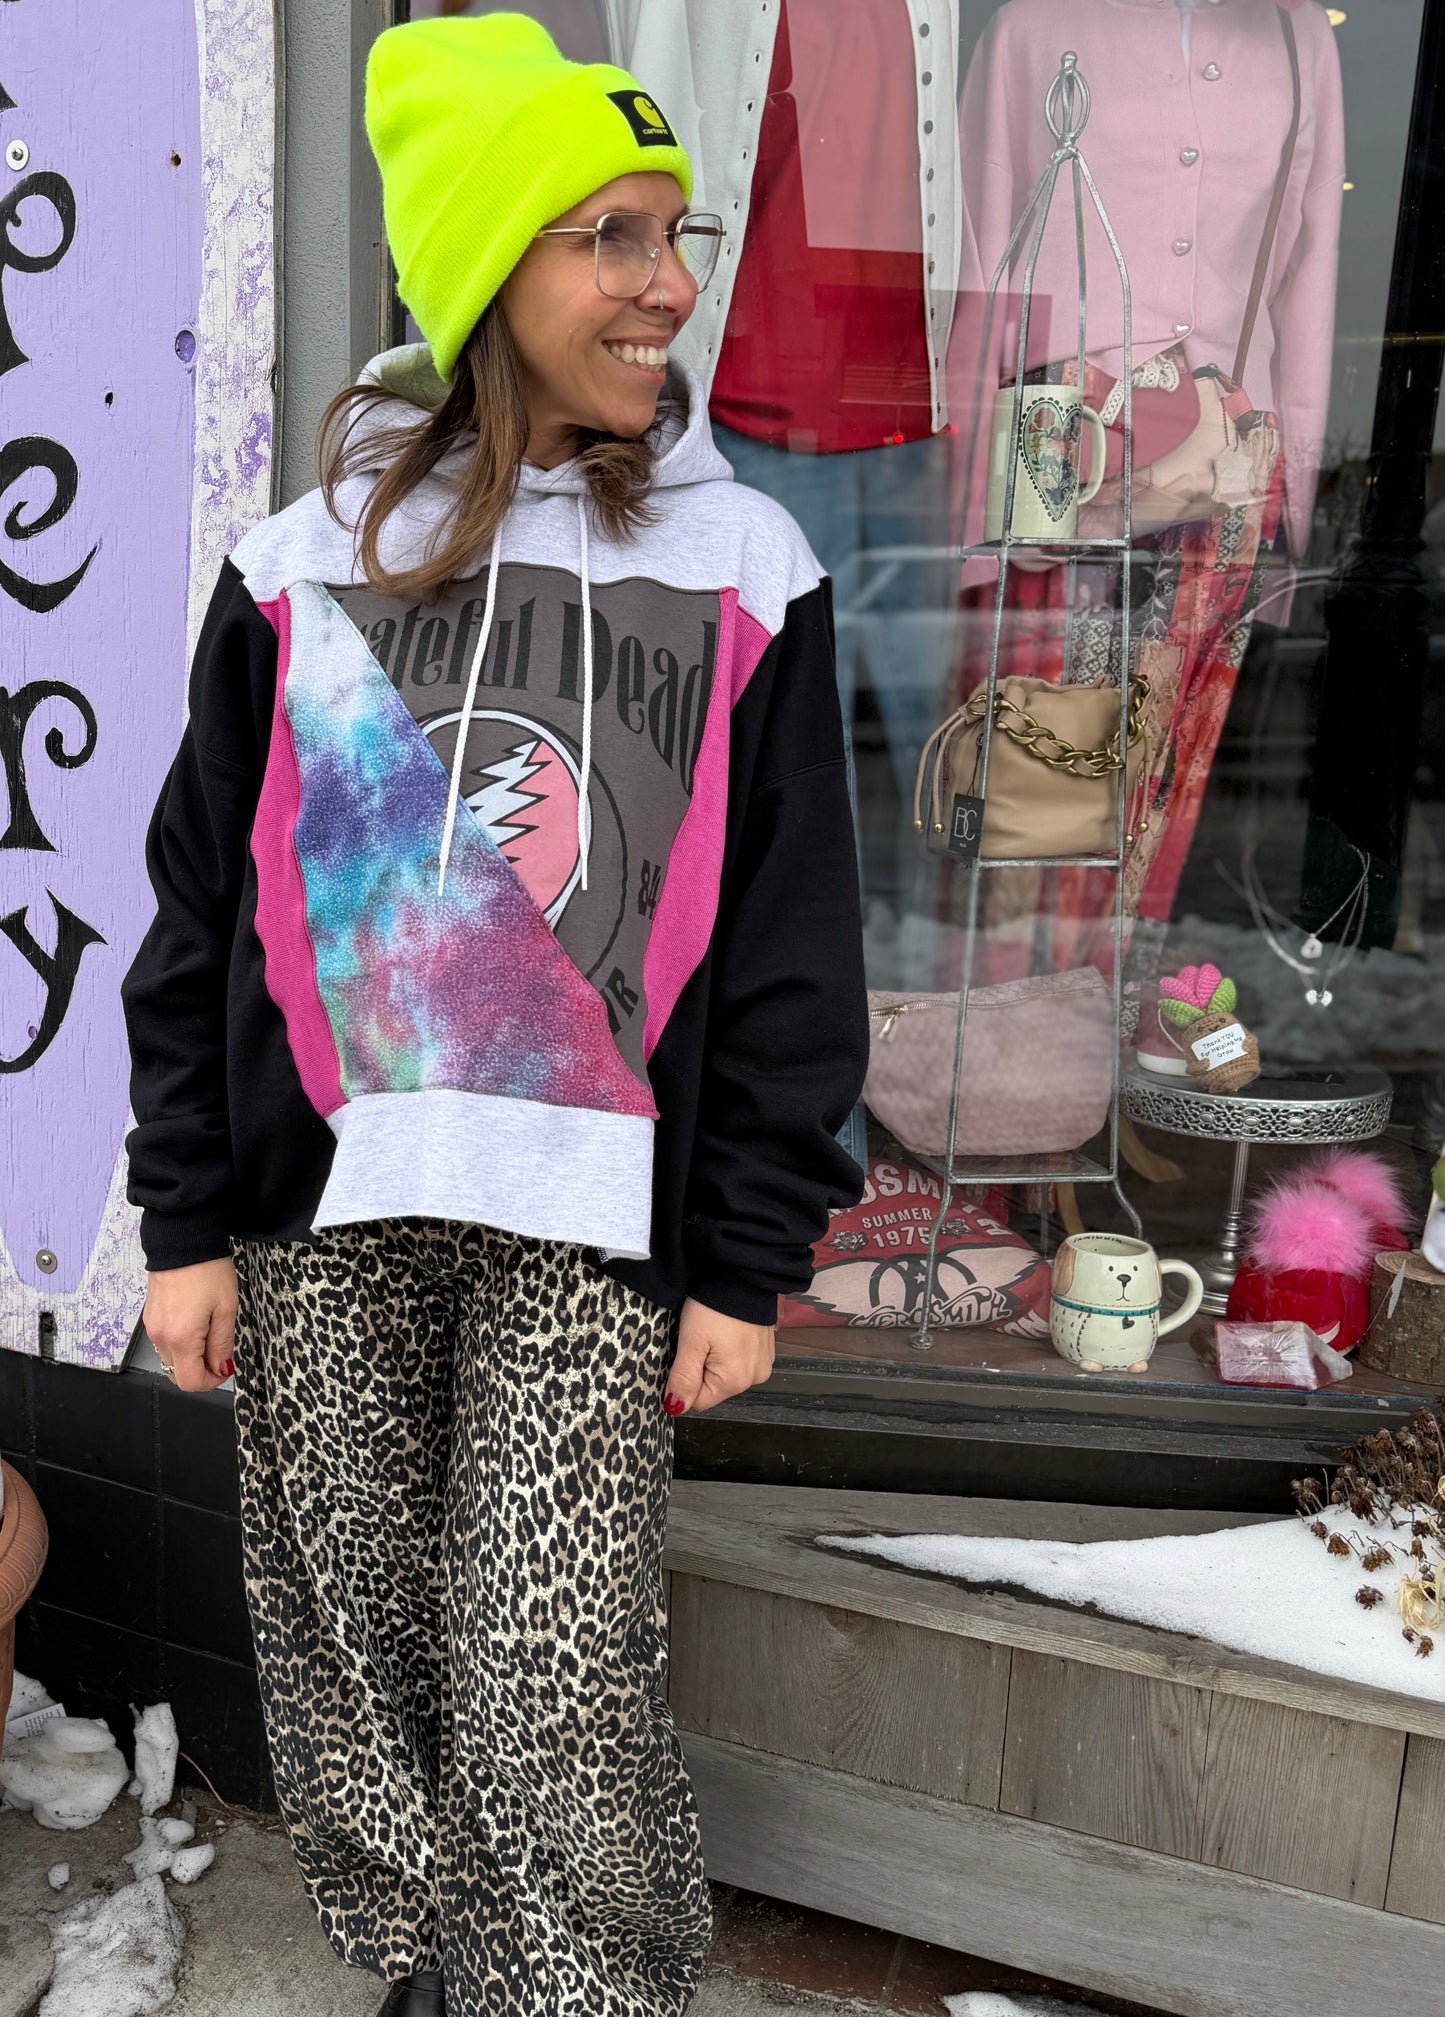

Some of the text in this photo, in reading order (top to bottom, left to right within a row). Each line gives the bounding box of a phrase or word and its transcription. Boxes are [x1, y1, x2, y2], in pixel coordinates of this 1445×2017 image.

[555, 601, 717, 798] Dead
[1202, 1038, 1221, 1049] Thank
[862, 1207, 933, 1229] SUMMER
[873, 1226, 931, 1248] 1975
